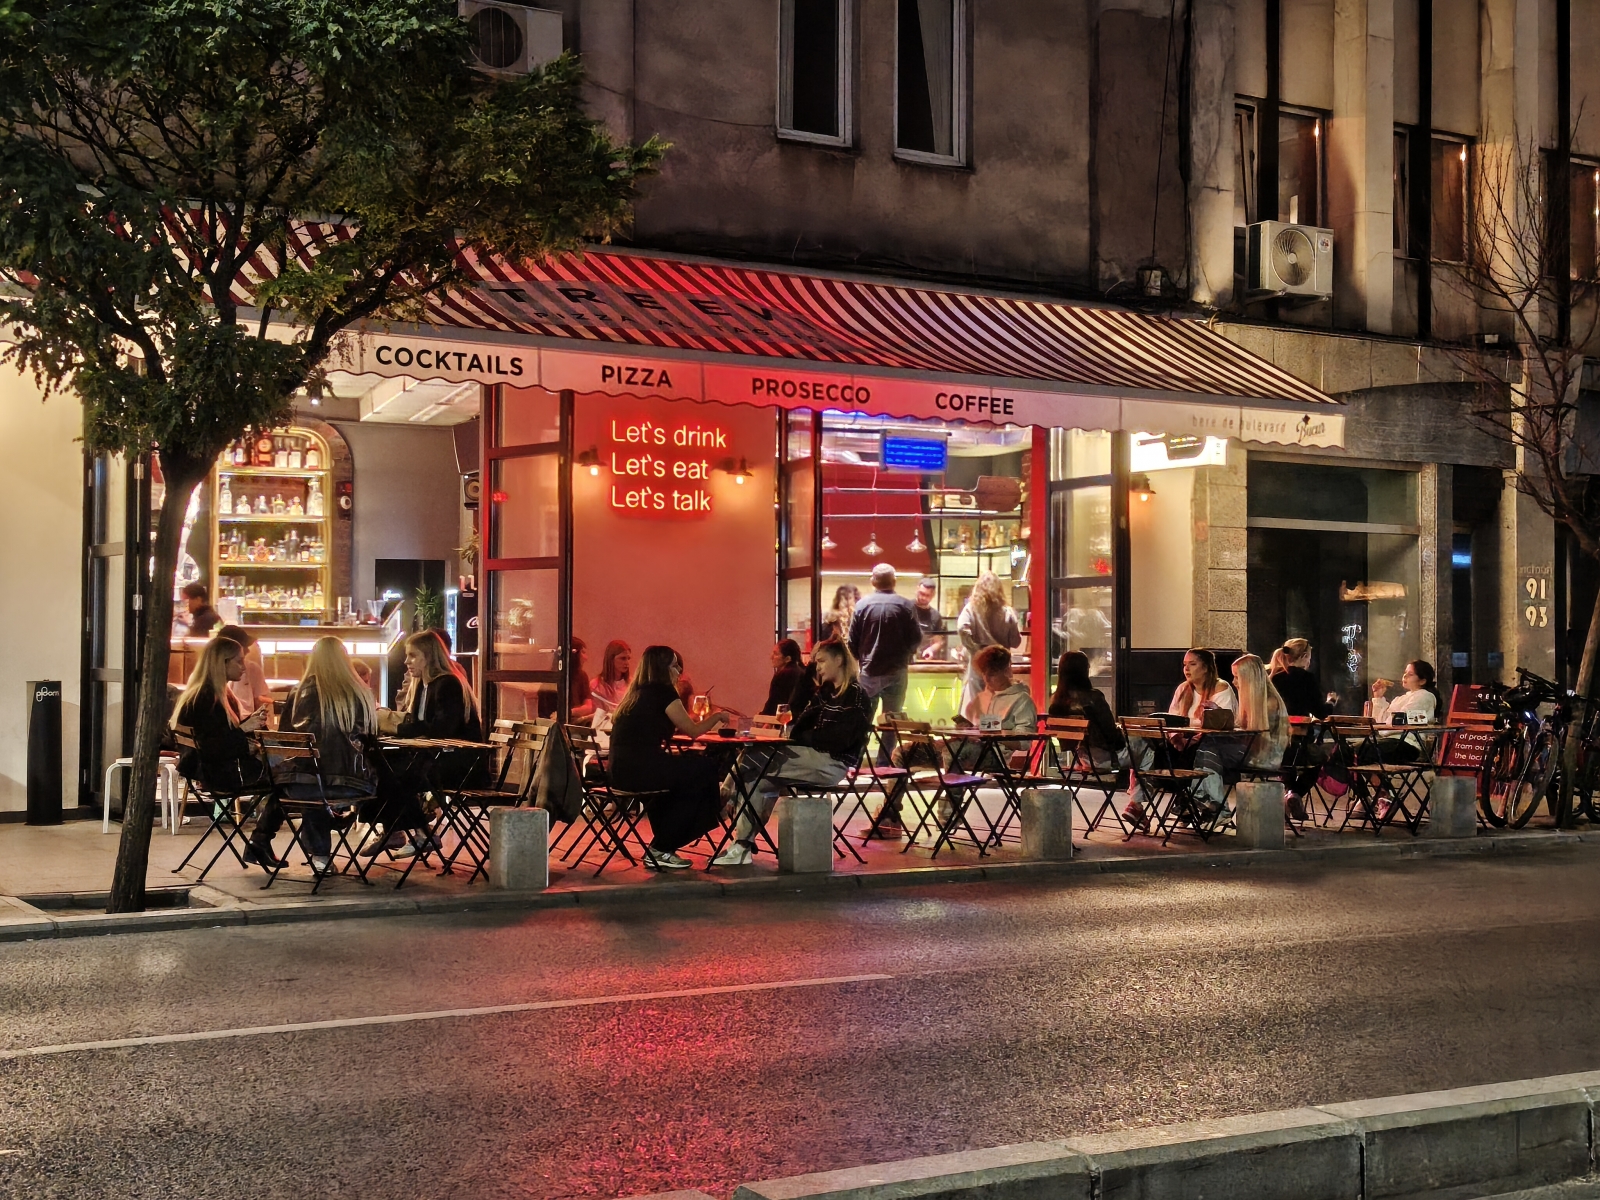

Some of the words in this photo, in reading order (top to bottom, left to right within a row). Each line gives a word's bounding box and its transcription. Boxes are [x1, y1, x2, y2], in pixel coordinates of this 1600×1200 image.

[376, 345, 524, 376] COCKTAILS
[601, 364, 673, 388] PIZZA
[752, 377, 871, 404] PROSECCO
[935, 392, 1014, 415] COFFEE
[612, 420, 666, 445] Let's
[673, 425, 727, 448] drink
[612, 452, 666, 478] Let's
[673, 459, 709, 480] eat
[612, 485, 665, 510] Let's
[672, 490, 711, 511] talk
[1526, 577, 1546, 599] 91
[1525, 605, 1548, 628] 93
